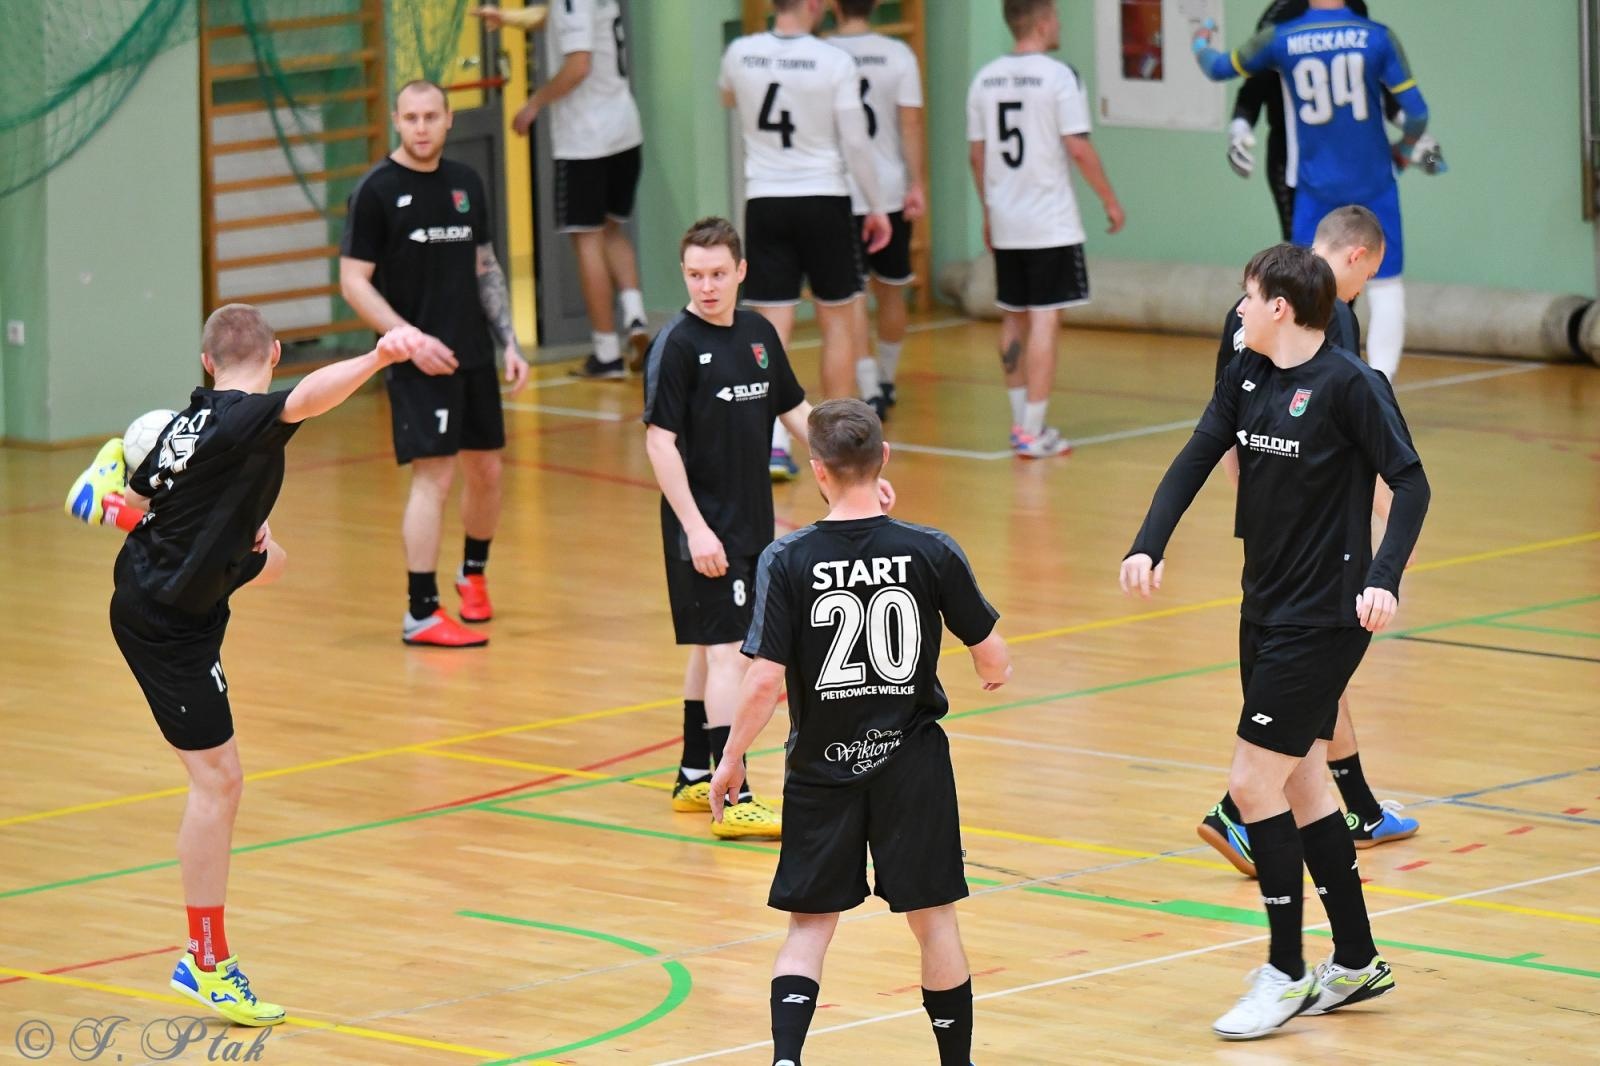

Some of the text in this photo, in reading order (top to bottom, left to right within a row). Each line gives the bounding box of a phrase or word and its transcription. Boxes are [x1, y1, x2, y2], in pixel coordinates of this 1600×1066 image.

[758, 82, 795, 148] 4
[1291, 52, 1368, 125] 94
[998, 101, 1024, 168] 5
[732, 579, 747, 607] 8
[811, 555, 912, 590] START
[810, 585, 922, 691] 20
[820, 684, 916, 701] PIETROWICE WIELKIE
